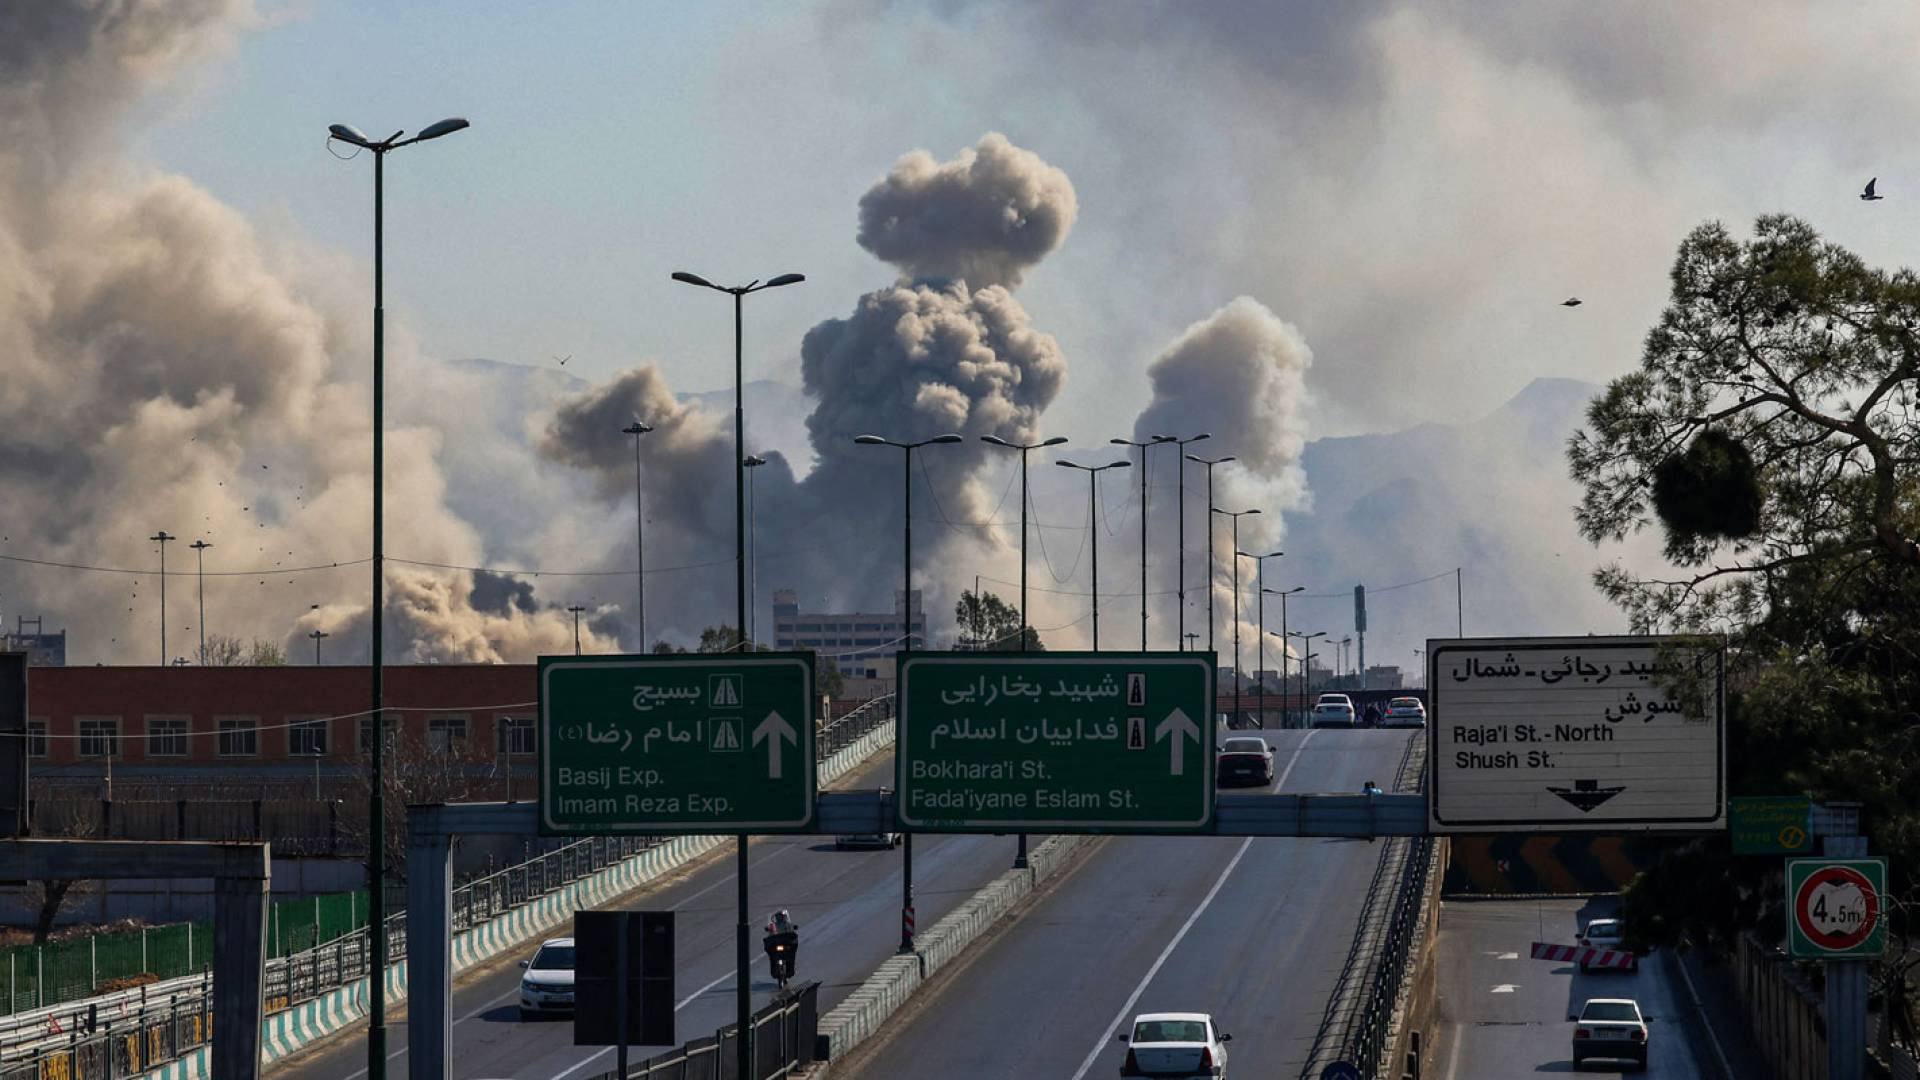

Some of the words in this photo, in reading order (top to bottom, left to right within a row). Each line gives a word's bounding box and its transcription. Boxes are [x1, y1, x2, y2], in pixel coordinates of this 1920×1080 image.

[632, 684, 701, 710] بسیج
[941, 674, 1042, 706] بخارایی
[1049, 673, 1120, 702] شهید
[644, 721, 702, 753] امام
[930, 718, 1006, 749] اسلام
[1016, 716, 1119, 747] فداییان
[1453, 725, 1508, 746] Raja'i
[912, 760, 1014, 780] Bokhara'i
[1021, 760, 1052, 780] St.
[1455, 751, 1519, 769] Shush
[1527, 751, 1555, 769] St.
[558, 767, 610, 789] Basij
[618, 767, 664, 788] Exp.
[558, 795, 617, 814] Imam
[625, 794, 680, 813] Reza
[688, 794, 734, 816] Exp.
[912, 789, 1028, 812] Fada'iyane
[1035, 789, 1101, 809] Eslam
[1108, 790, 1140, 809] St.
[1813, 893, 1861, 924] 4.5m
